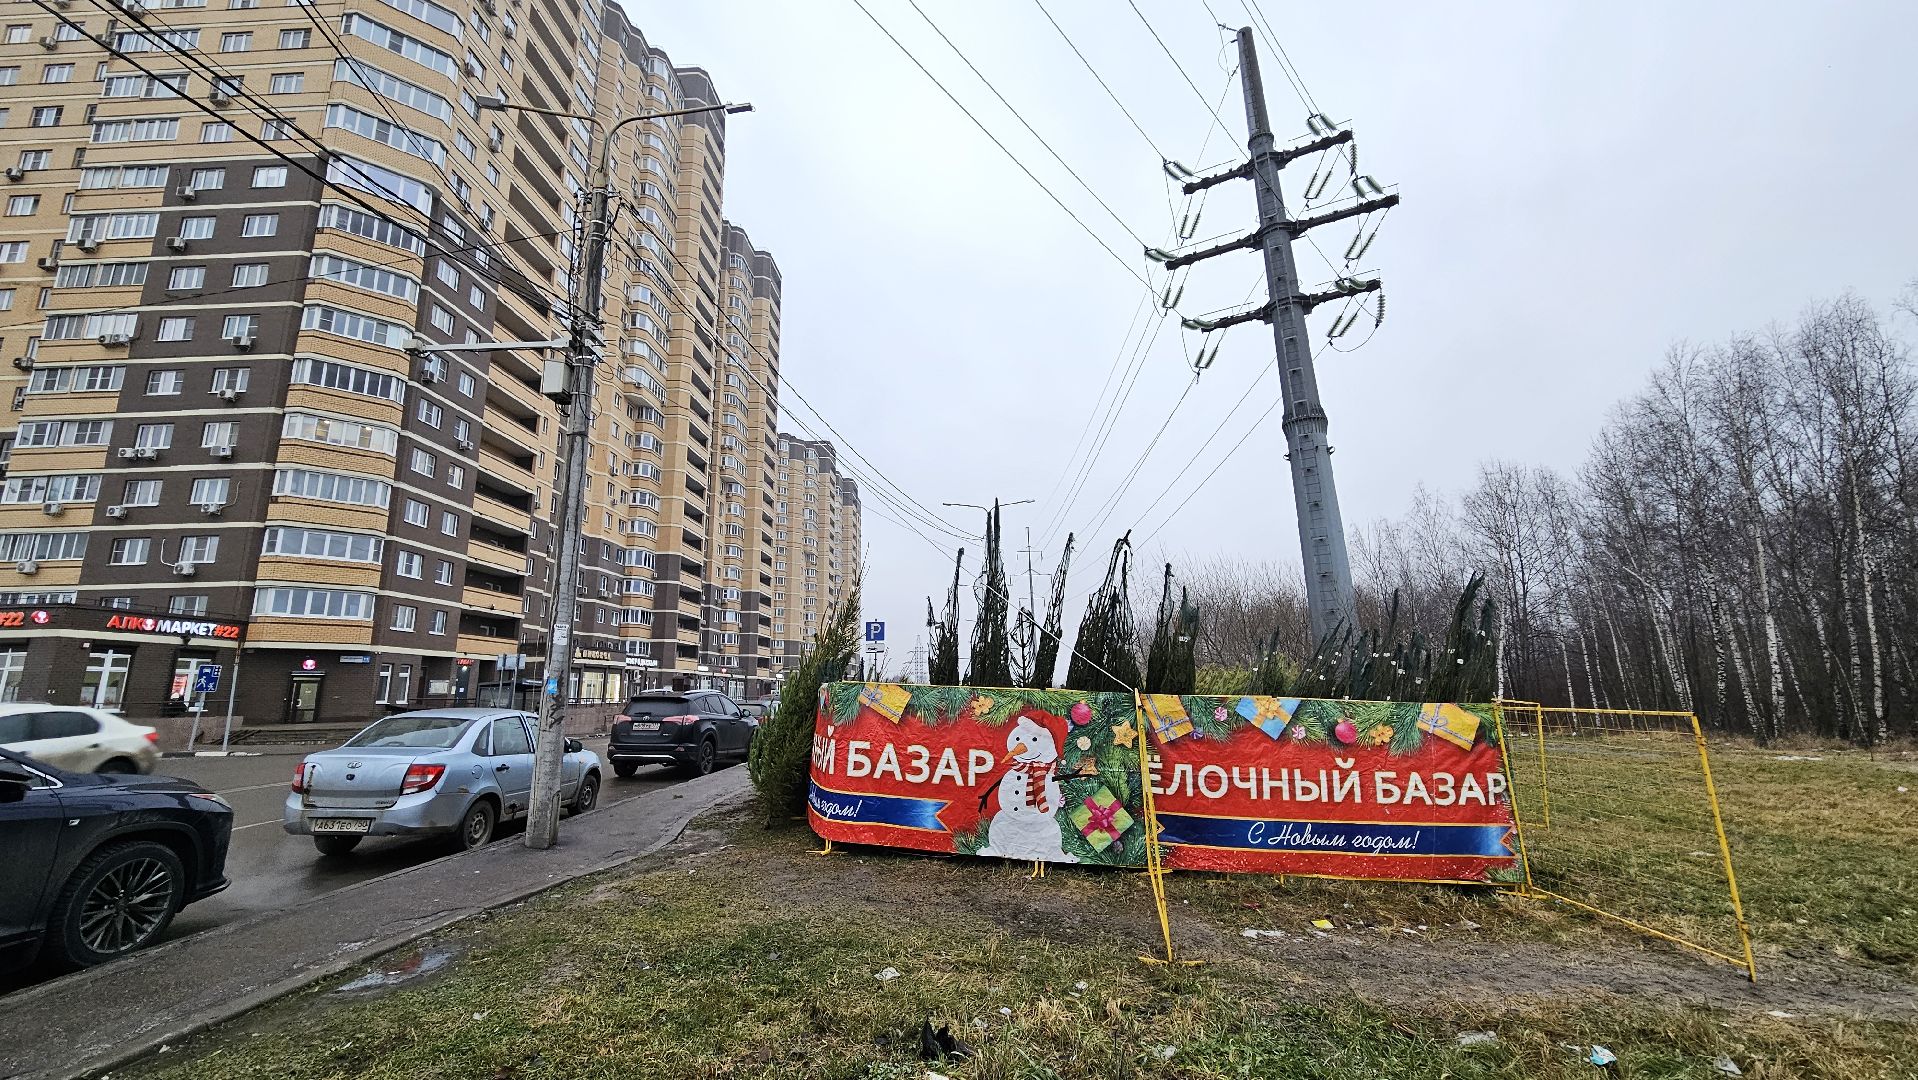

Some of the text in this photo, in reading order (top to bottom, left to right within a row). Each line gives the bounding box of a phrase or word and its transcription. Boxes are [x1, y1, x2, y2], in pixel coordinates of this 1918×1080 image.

[870, 623, 881, 640] P
[846, 740, 995, 787] БАЗАР
[1148, 755, 1507, 806] ЁЛОЧНЫЙ БАЗАР
[1247, 821, 1420, 855] С Новым годом!
